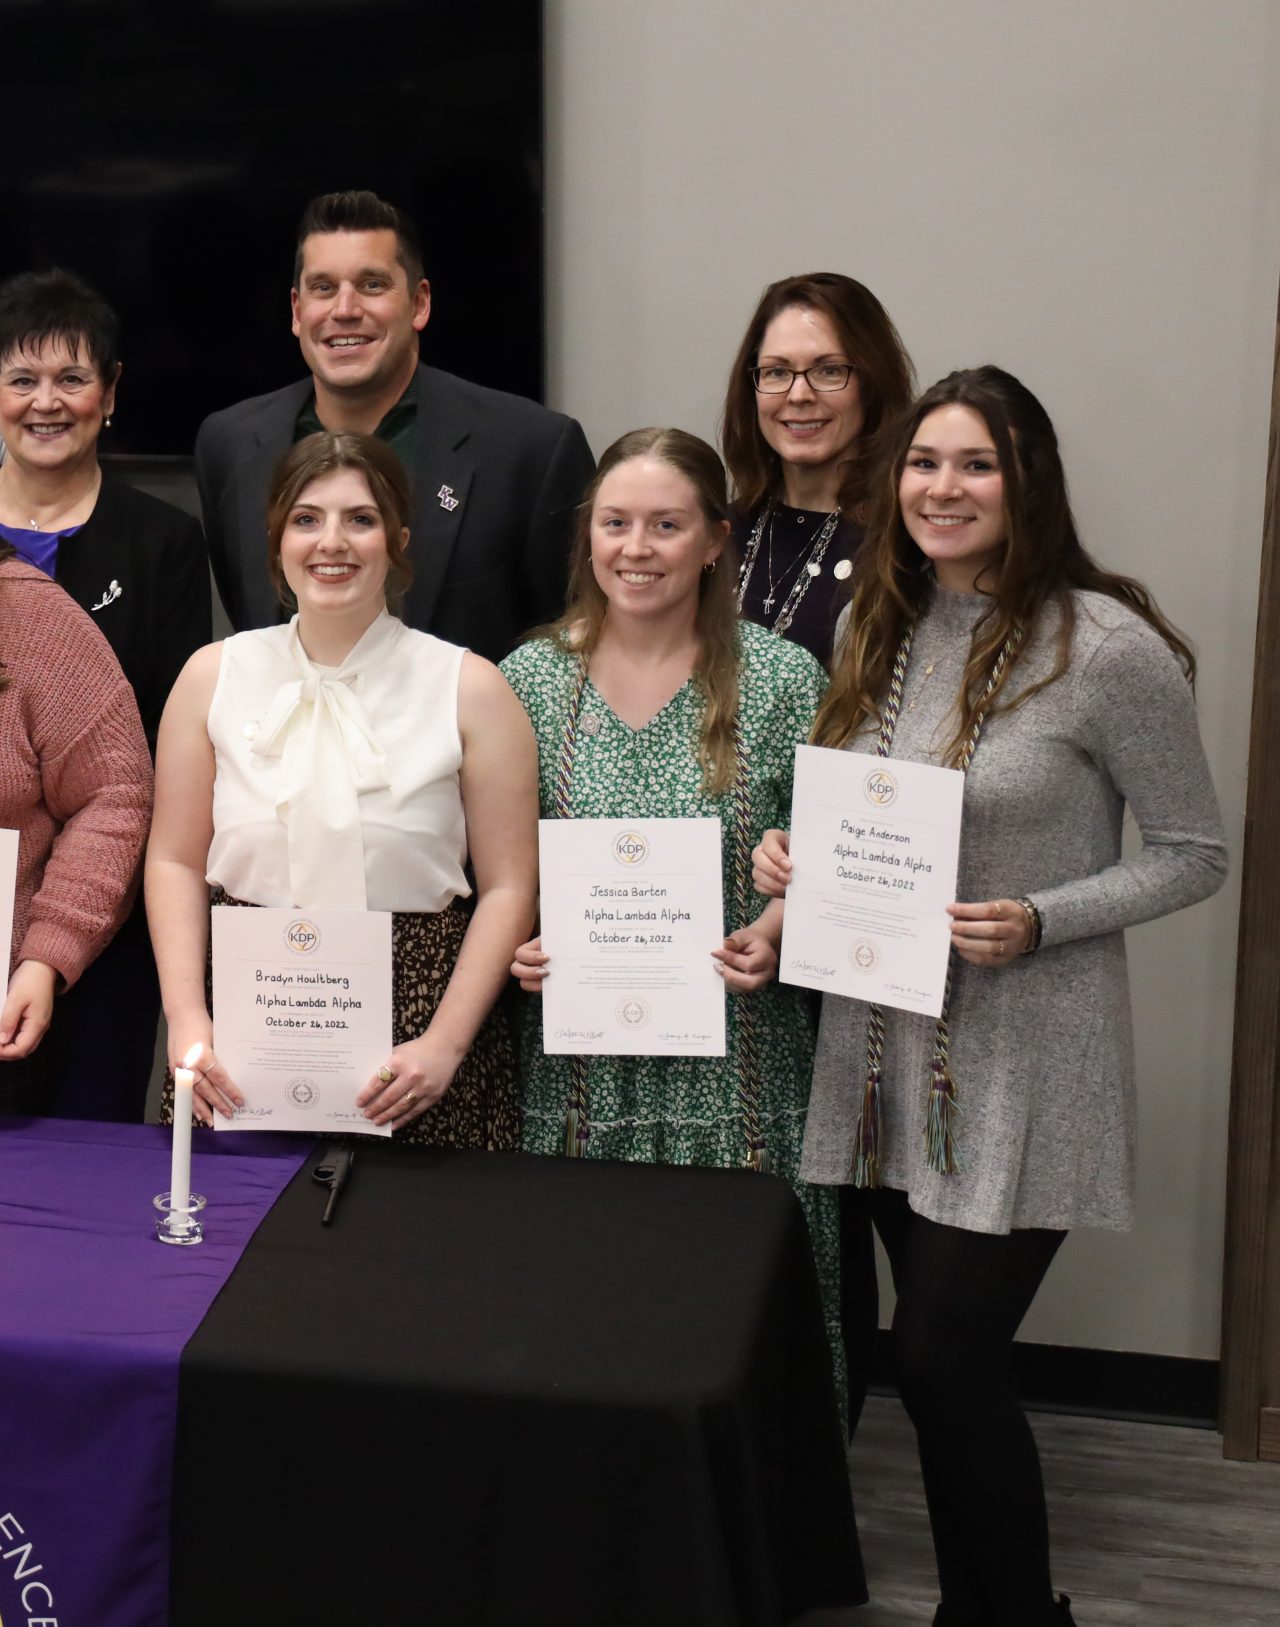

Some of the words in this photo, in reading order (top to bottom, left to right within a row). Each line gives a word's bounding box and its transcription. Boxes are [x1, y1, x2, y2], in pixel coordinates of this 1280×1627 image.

[870, 783, 892, 793] KDP
[841, 820, 866, 838] Paige
[869, 827, 910, 844] Anderson
[619, 845, 643, 853] KDP
[833, 844, 858, 860] Alpha
[862, 849, 900, 866] Lambda
[904, 856, 931, 873] Alpha
[837, 866, 875, 883] October
[878, 875, 890, 887] 26,
[892, 878, 915, 891] 2022
[590, 886, 628, 897] Jessica
[632, 884, 666, 897] Barten
[584, 909, 613, 924] Alpha
[616, 910, 656, 921] Lambda
[660, 908, 690, 924] Alpha
[291, 933, 314, 943] KDP
[590, 931, 629, 943] October
[635, 935, 647, 945] 26,
[650, 935, 673, 943] 2022
[256, 970, 293, 985] Bradyn
[297, 971, 349, 989] Houltberg
[256, 994, 286, 1008] Alpha
[289, 996, 326, 1008] Lambda
[332, 994, 362, 1011] Alpha
[266, 1017, 307, 1028] October
[310, 1021, 322, 1029] 26,
[325, 1021, 349, 1029] 2022
